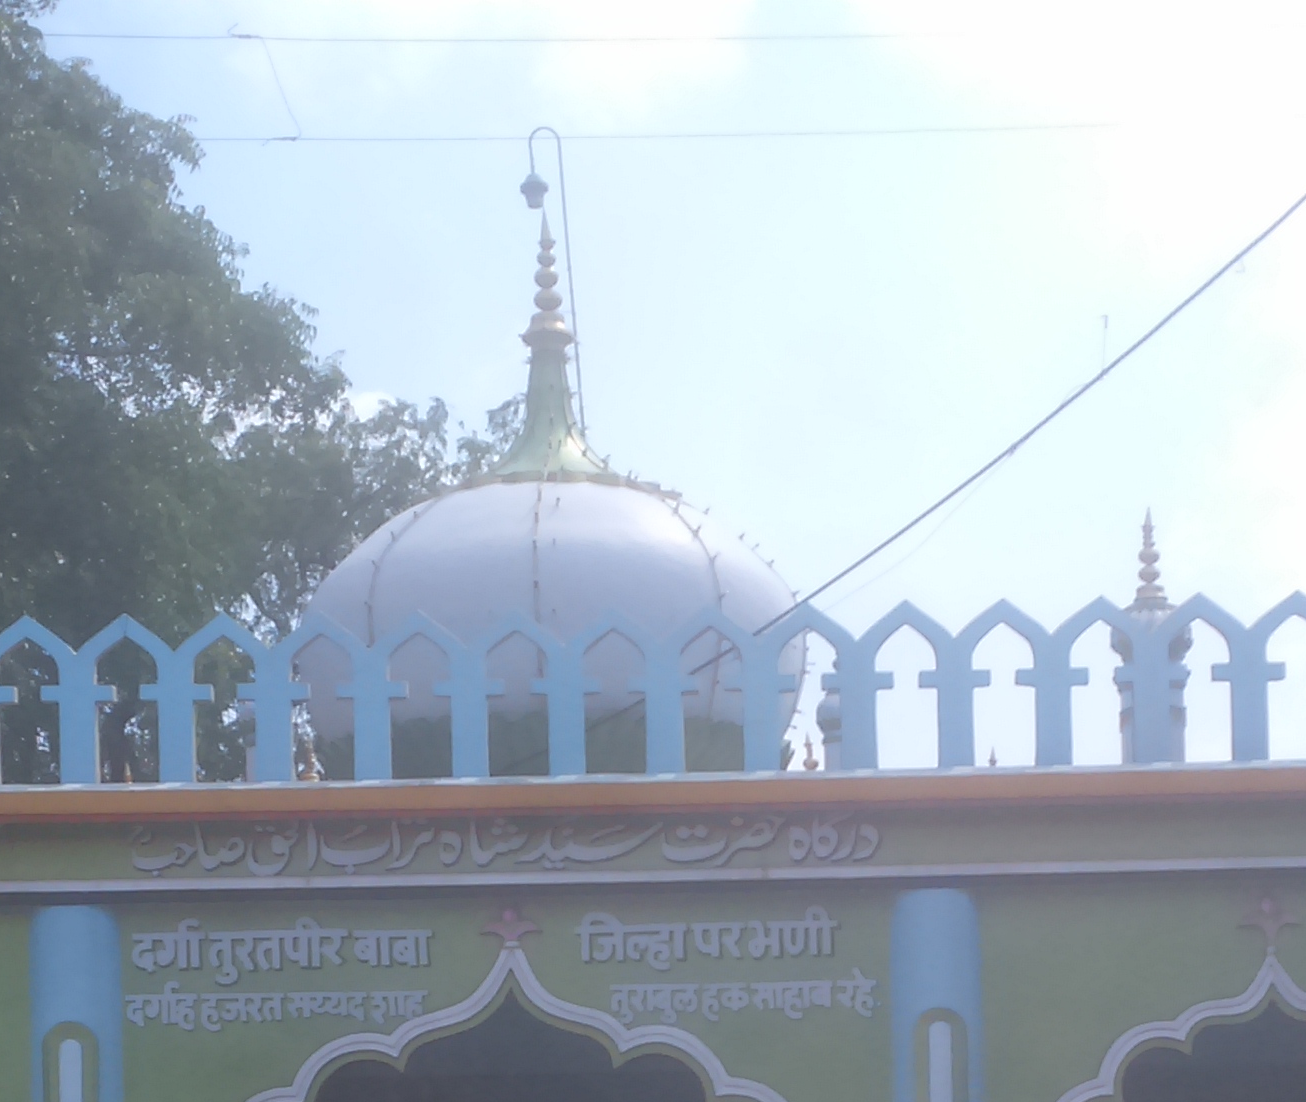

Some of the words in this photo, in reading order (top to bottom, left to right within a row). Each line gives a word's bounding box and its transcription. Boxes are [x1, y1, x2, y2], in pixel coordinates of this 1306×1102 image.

[132, 918, 206, 972] दर्गा
[353, 929, 432, 967] बाबा
[574, 911, 689, 971] जिल्हा
[200, 992, 284, 1031] हजरत
[370, 989, 428, 1023] शाह
[610, 984, 699, 1024] तुराबुल
[702, 982, 749, 1021] हक
